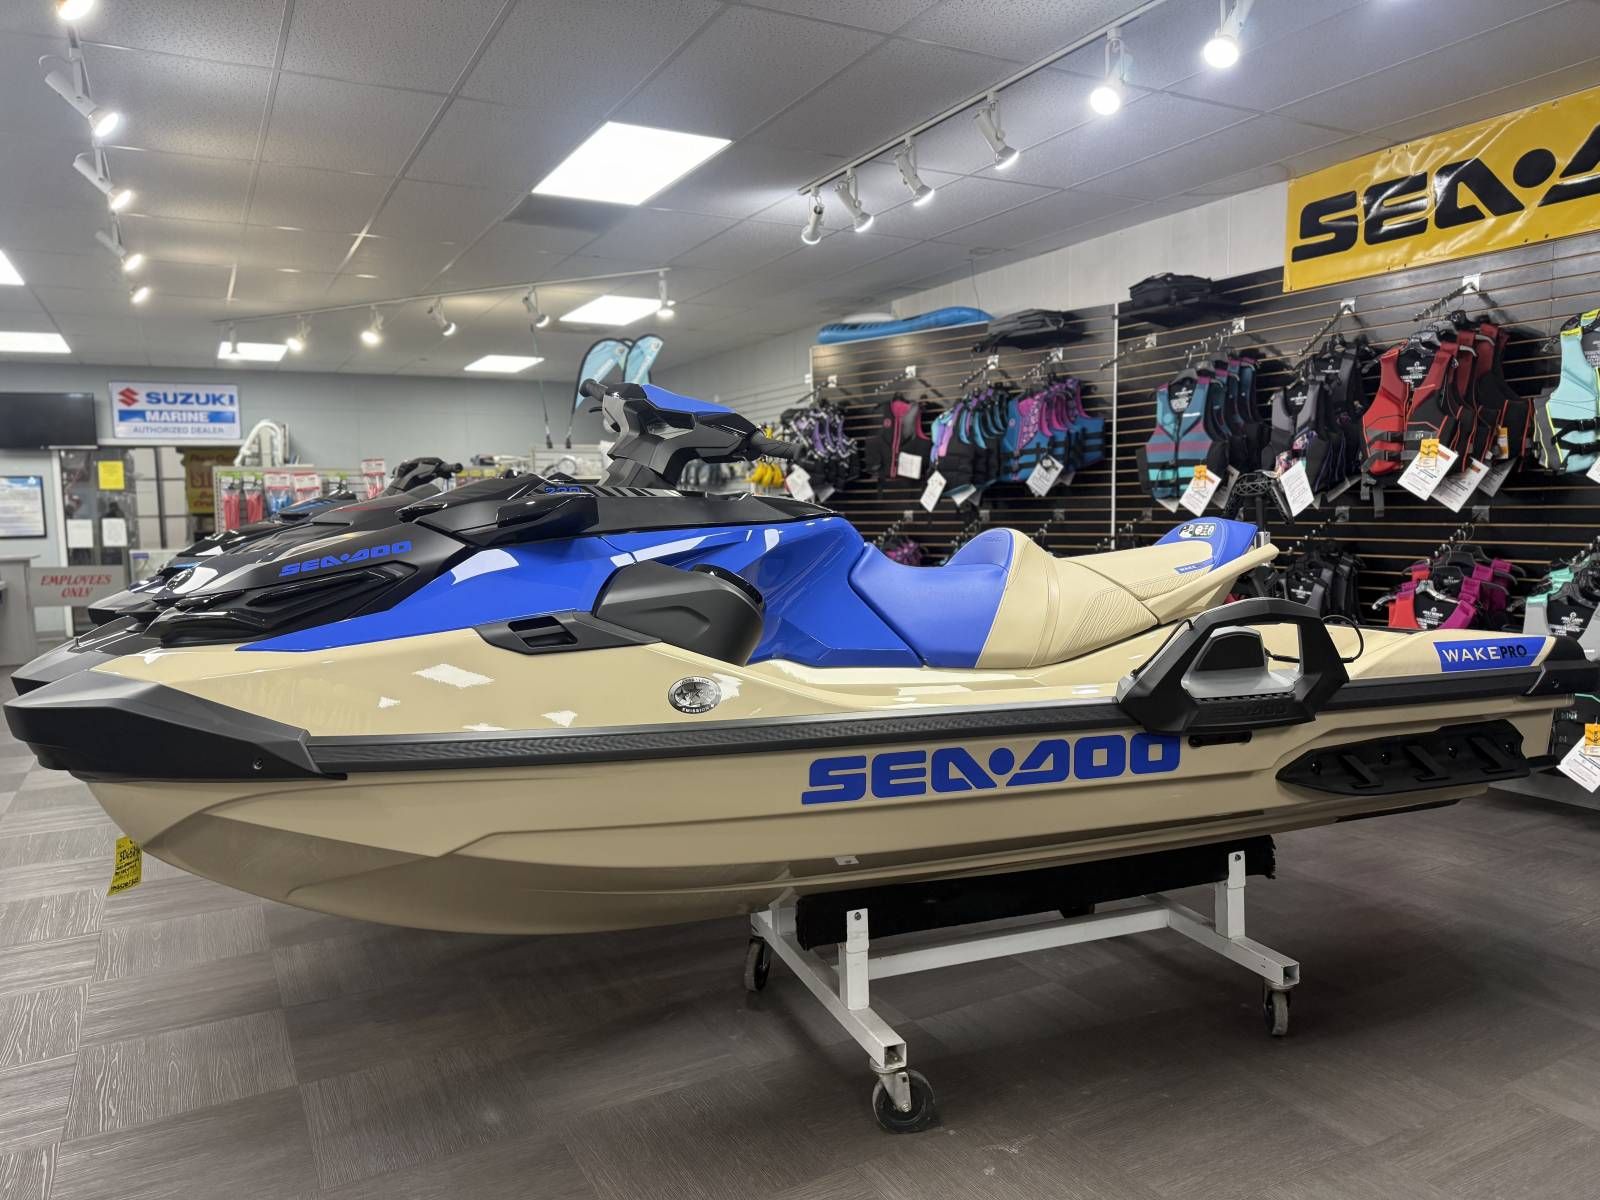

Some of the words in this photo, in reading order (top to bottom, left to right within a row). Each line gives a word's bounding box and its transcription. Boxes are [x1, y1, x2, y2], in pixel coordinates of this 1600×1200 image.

[145, 391, 235, 406] SUZUKI
[145, 410, 209, 423] MARINE
[133, 426, 189, 434] AUTHORIZED
[191, 426, 224, 434] DEALER
[41, 574, 113, 586] EMPLOYEES
[61, 586, 94, 598] ONLY
